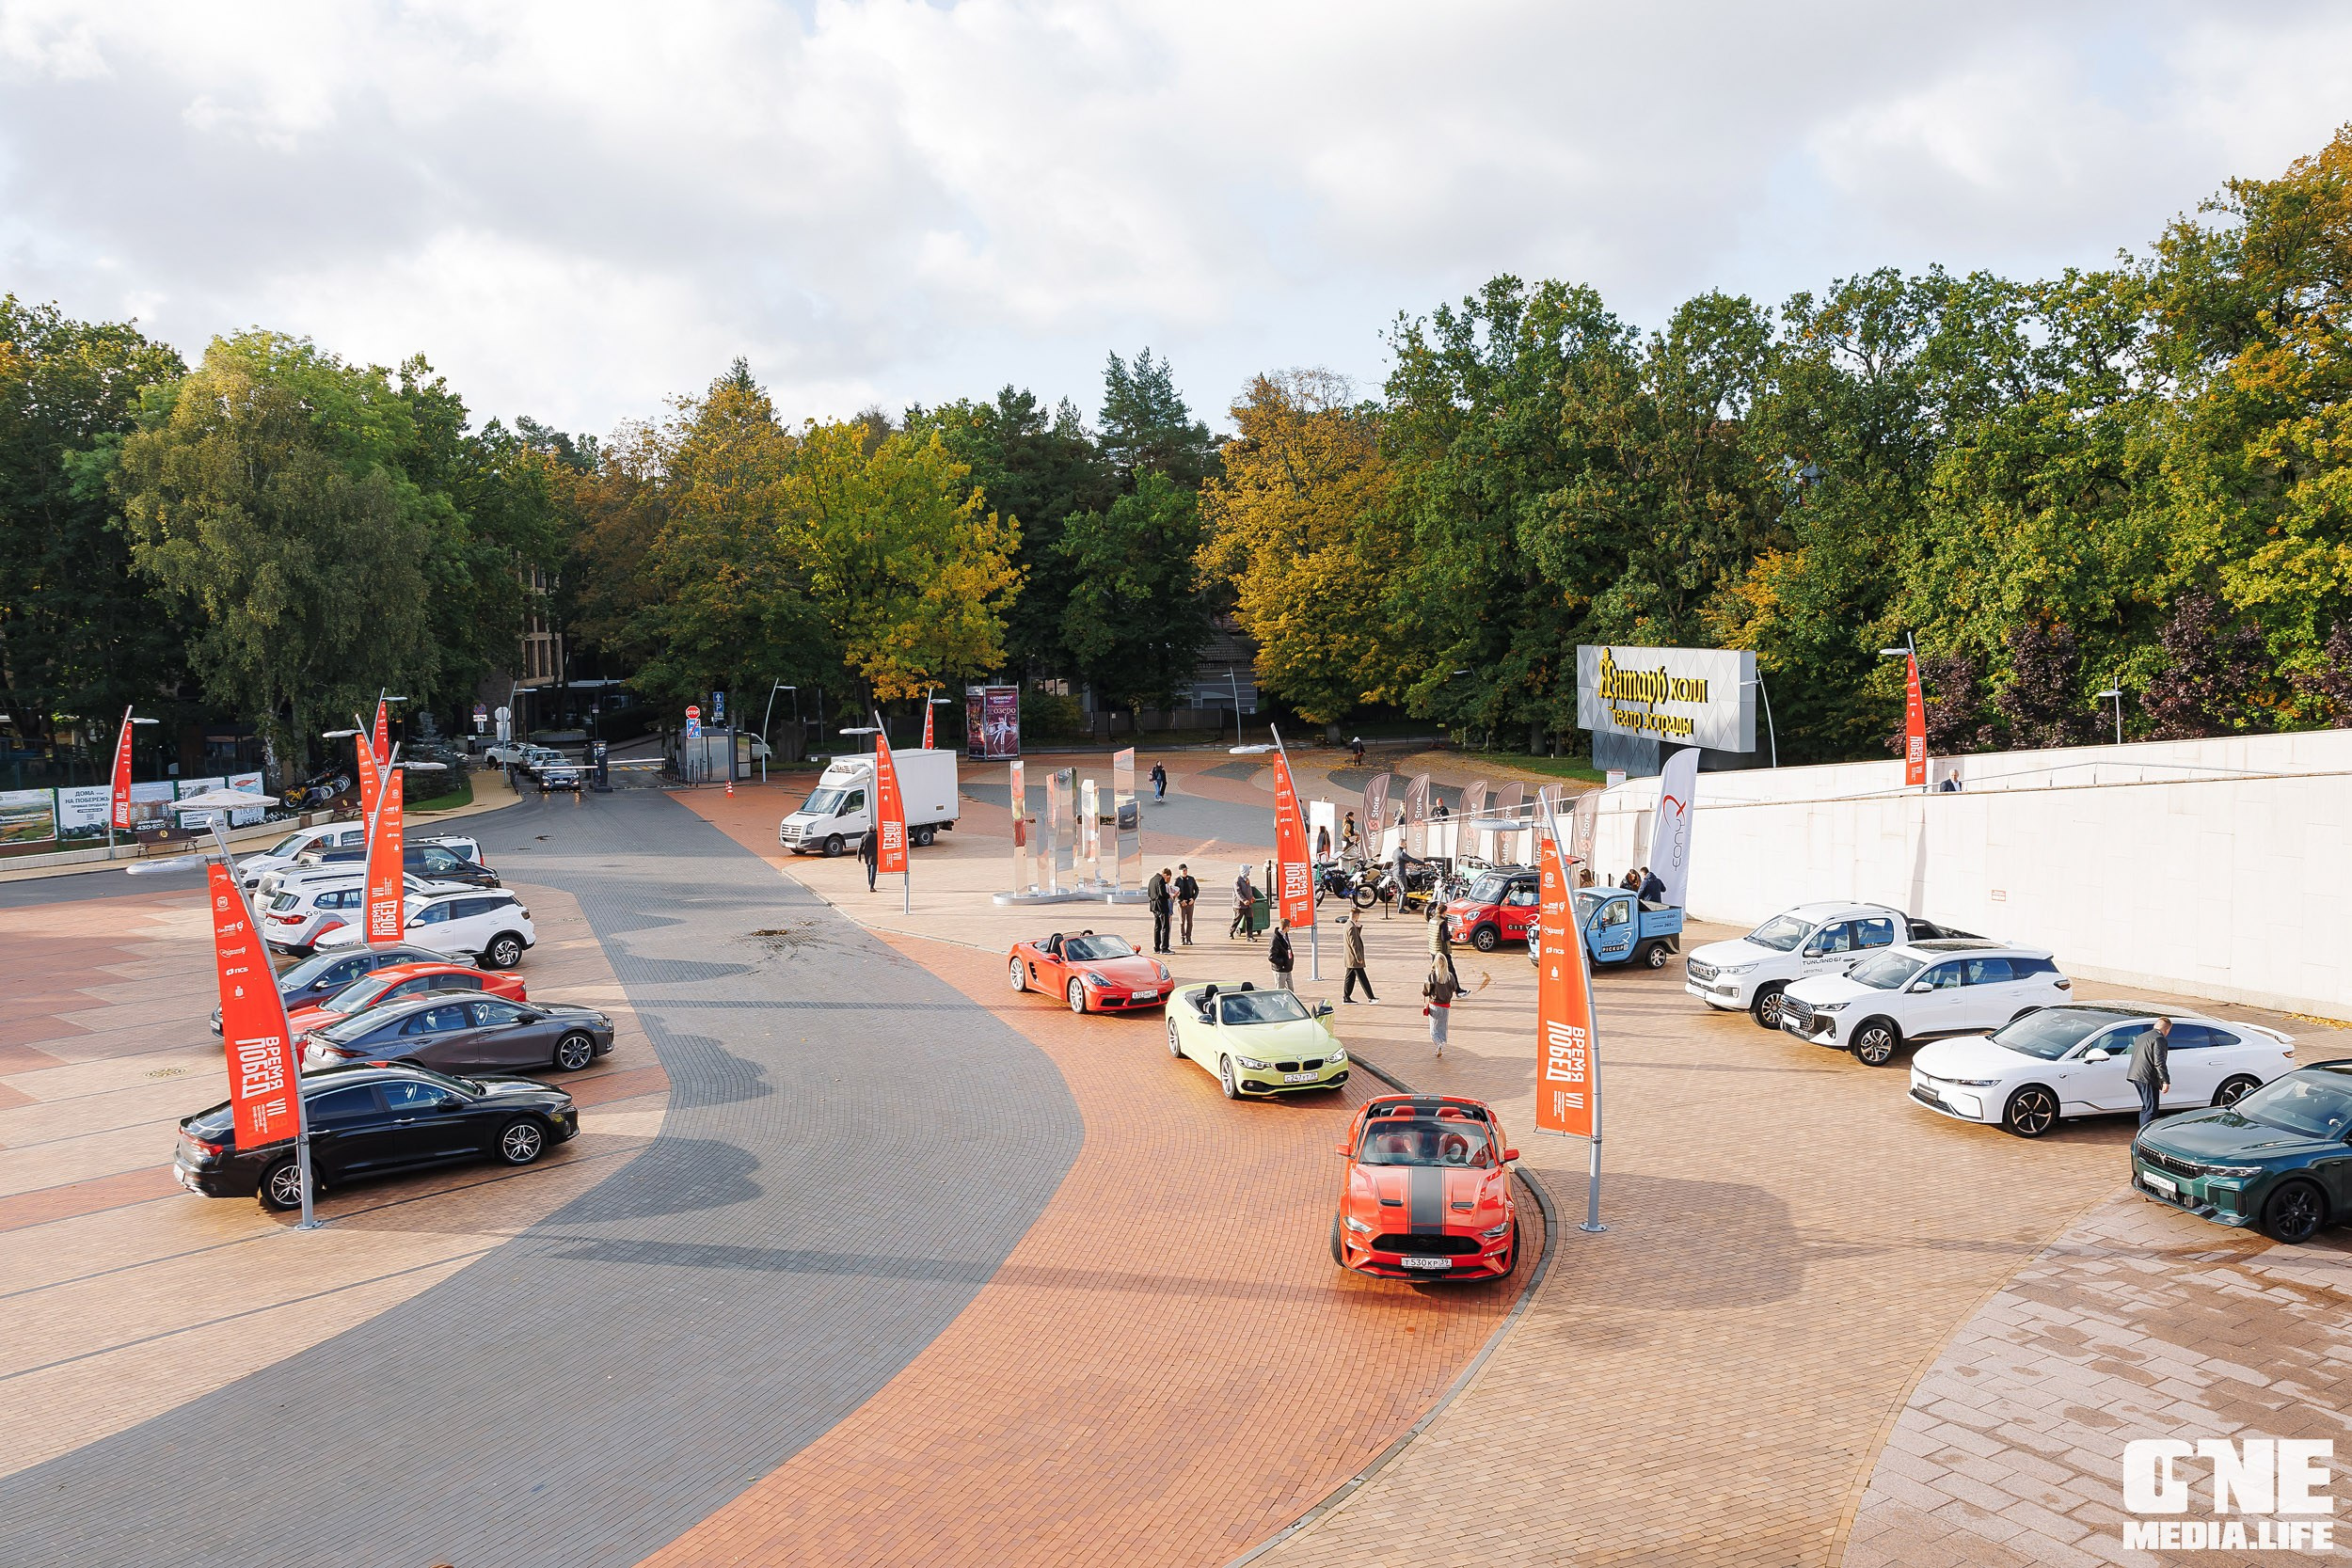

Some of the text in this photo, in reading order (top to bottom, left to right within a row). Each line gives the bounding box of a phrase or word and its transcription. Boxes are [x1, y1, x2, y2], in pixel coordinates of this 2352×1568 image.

[1669, 678, 1707, 703] холл
[1613, 708, 1693, 737] театр эстрады
[1909, 736, 1920, 763] ПОБЕД
[1372, 796, 1380, 817] Store
[882, 820, 896, 849] ПОБЕД
[1581, 813, 1591, 838] Store
[1502, 843, 1510, 864] Auto
[372, 887, 385, 897] VII
[1283, 862, 1300, 899] ПОБЕД
[1298, 863, 1308, 896] ВРЕМЯ
[372, 903, 381, 935] ВРЕМЯ
[380, 899, 398, 935] ПОБЕД
[1297, 900, 1309, 911] VII
[265, 1036, 284, 1091] ВРЕМЯ
[1546, 1020, 1573, 1082] ПОБЕД
[1571, 1026, 1586, 1083] ВРЕМЯ
[235, 1037, 271, 1100] ПОБЕД
[266, 1098, 286, 1117] VII
[1565, 1092, 1584, 1109] VII
